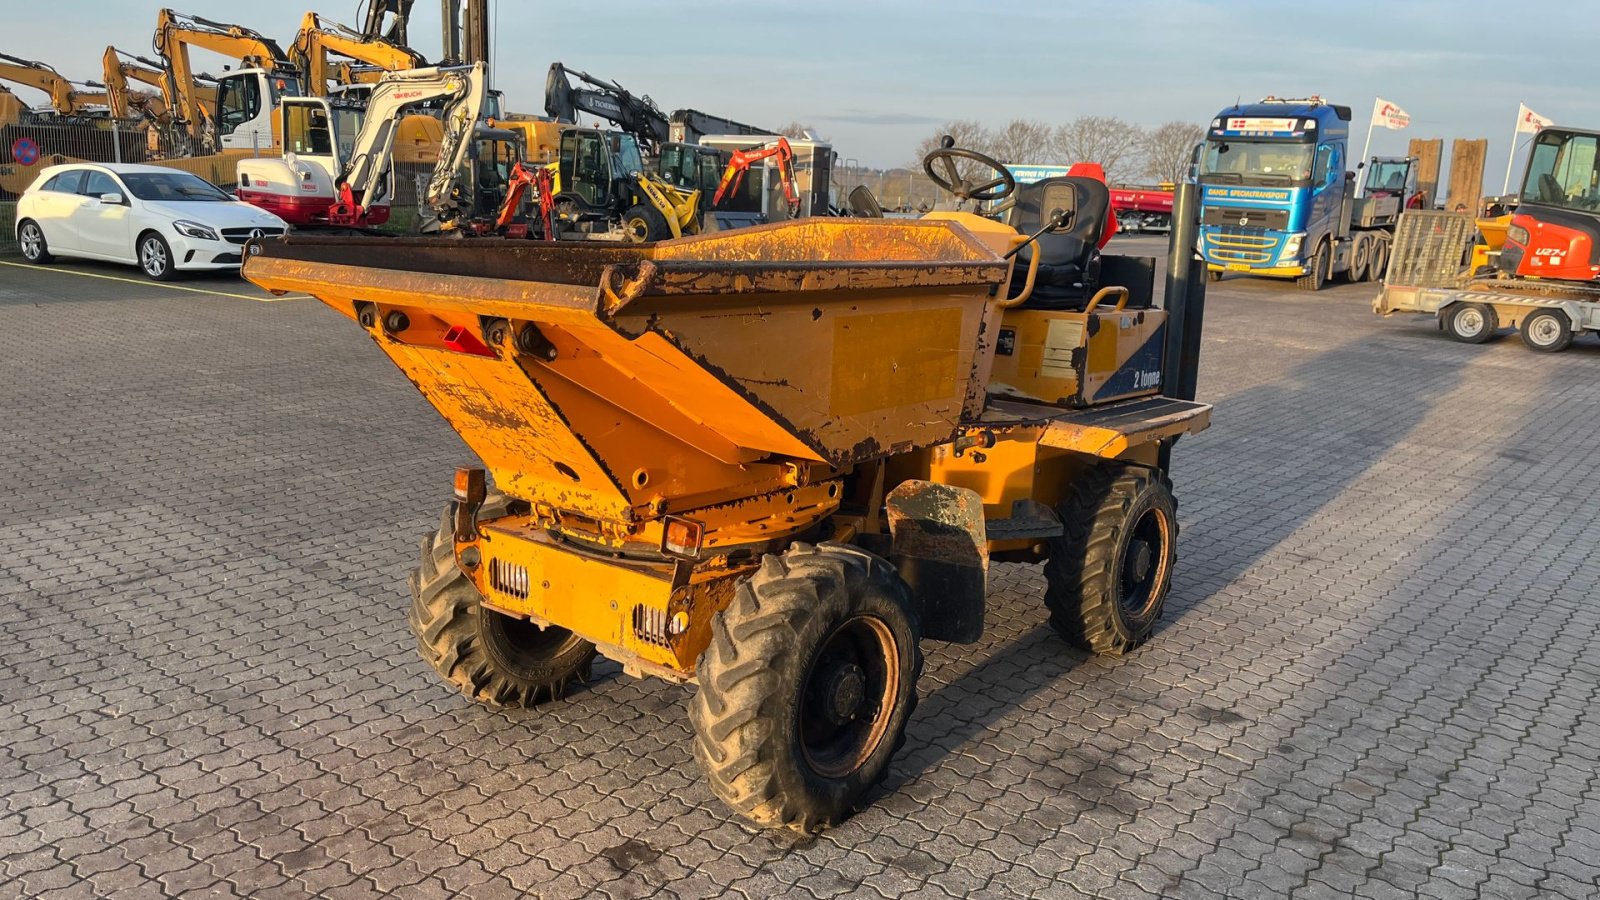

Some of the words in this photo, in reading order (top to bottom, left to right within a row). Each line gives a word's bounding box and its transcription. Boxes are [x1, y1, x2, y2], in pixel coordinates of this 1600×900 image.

[393, 91, 422, 99] TAKEUCHI
[594, 99, 621, 112] TSCHERNIN
[646, 184, 666, 209] KOMATSU
[1208, 188, 1229, 196] DANSK
[1230, 189, 1288, 199] SPECIALTRANSPORT
[1133, 370, 1140, 389] 2
[1140, 369, 1161, 388] tonne
